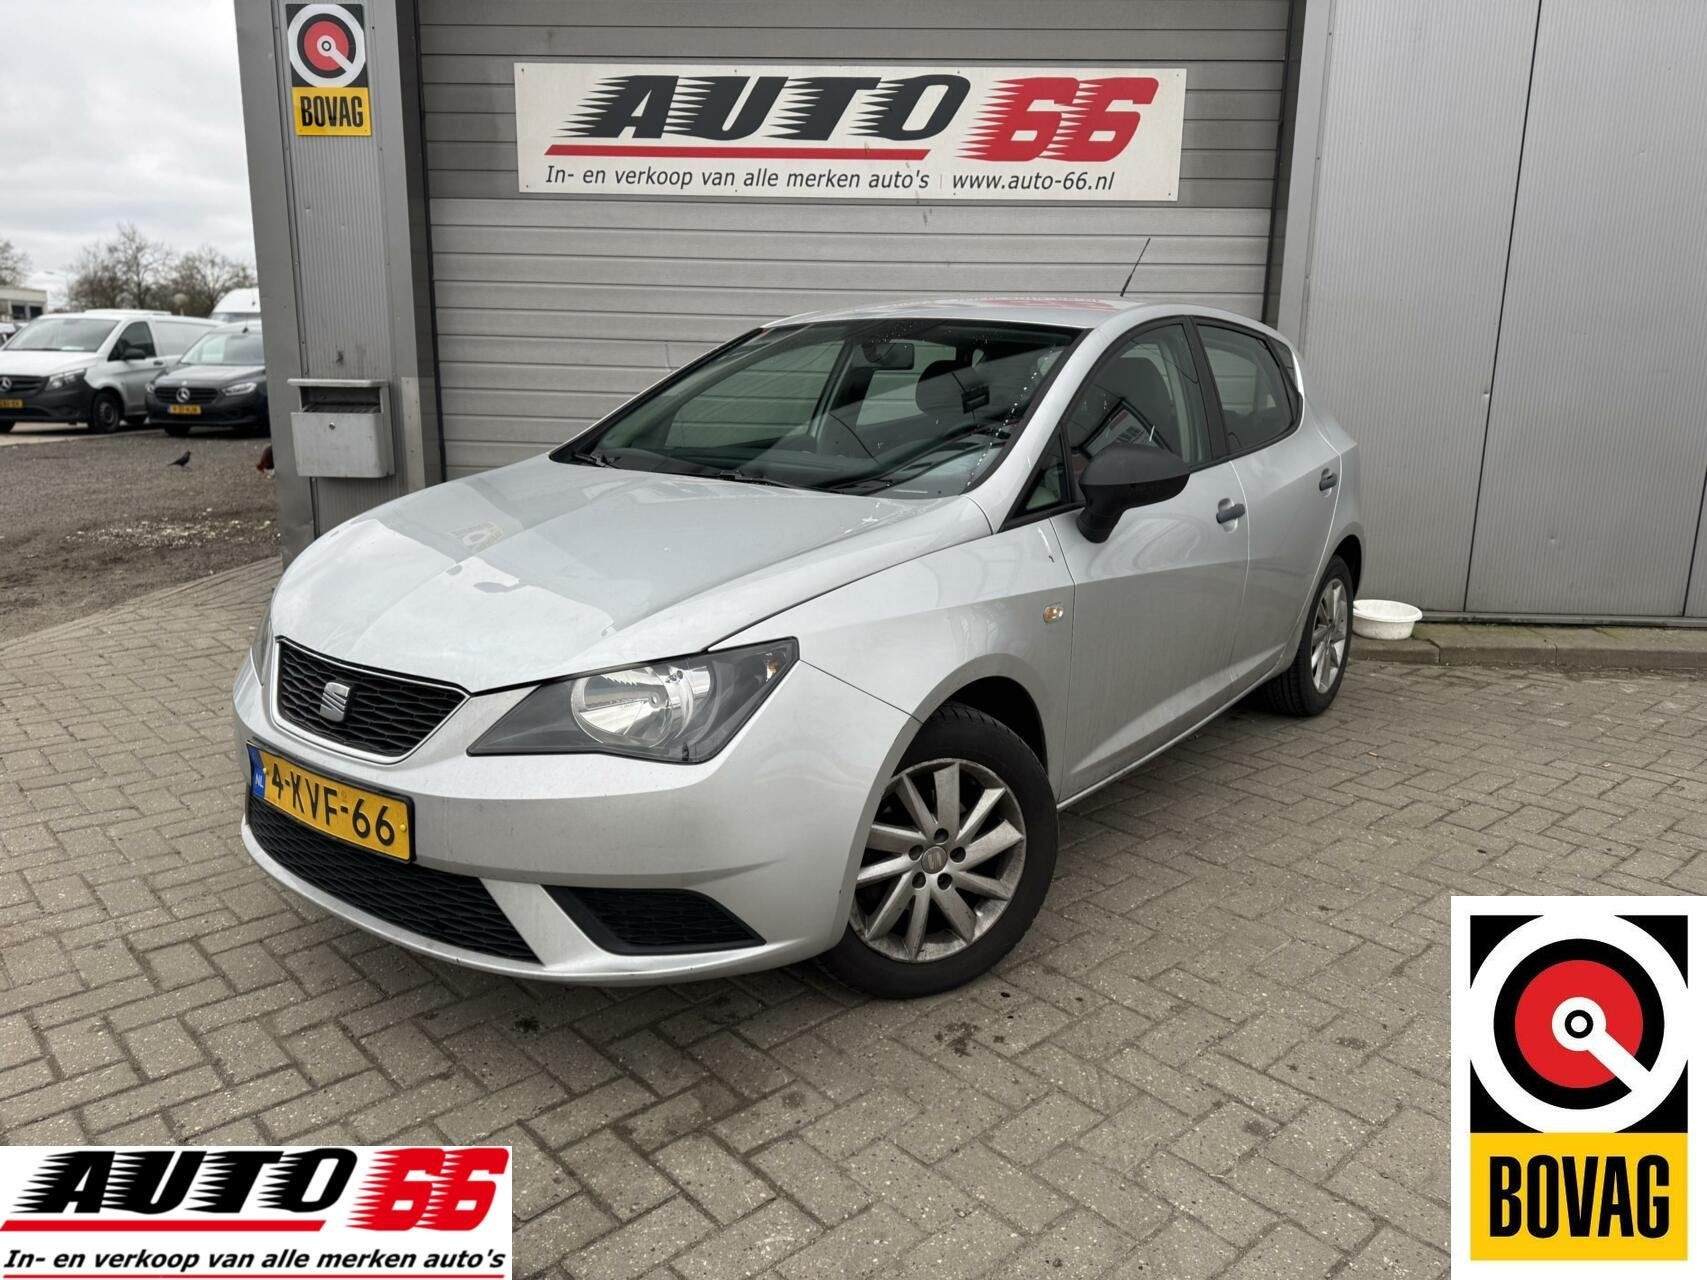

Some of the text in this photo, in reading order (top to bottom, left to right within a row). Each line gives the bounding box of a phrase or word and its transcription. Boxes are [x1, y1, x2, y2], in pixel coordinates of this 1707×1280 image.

[300, 96, 364, 127] BOVAG
[553, 74, 1160, 162] AUTO 66
[546, 165, 930, 190] In- en verkoop van alle merken auto's
[953, 171, 1115, 190] www.auto-66.nl
[272, 763, 395, 846] 4-KVF-66
